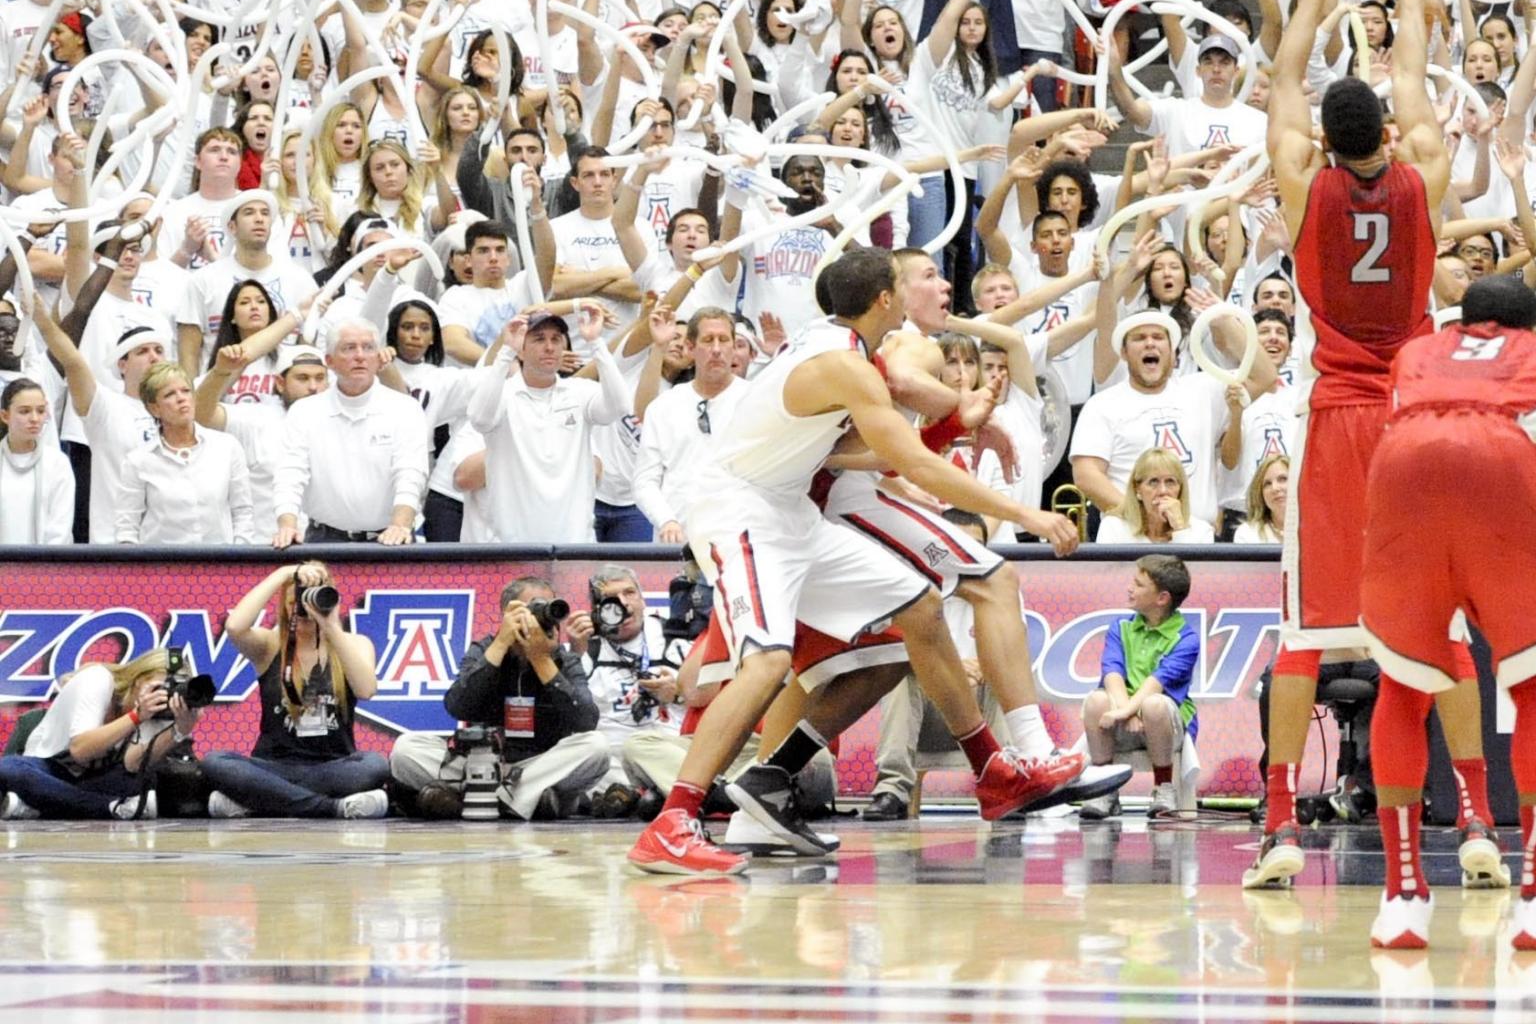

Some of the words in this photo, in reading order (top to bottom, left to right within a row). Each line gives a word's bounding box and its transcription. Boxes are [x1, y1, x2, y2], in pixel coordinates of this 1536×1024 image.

[1350, 212, 1391, 284] 2
[1152, 421, 1193, 464] A
[922, 542, 950, 568] A
